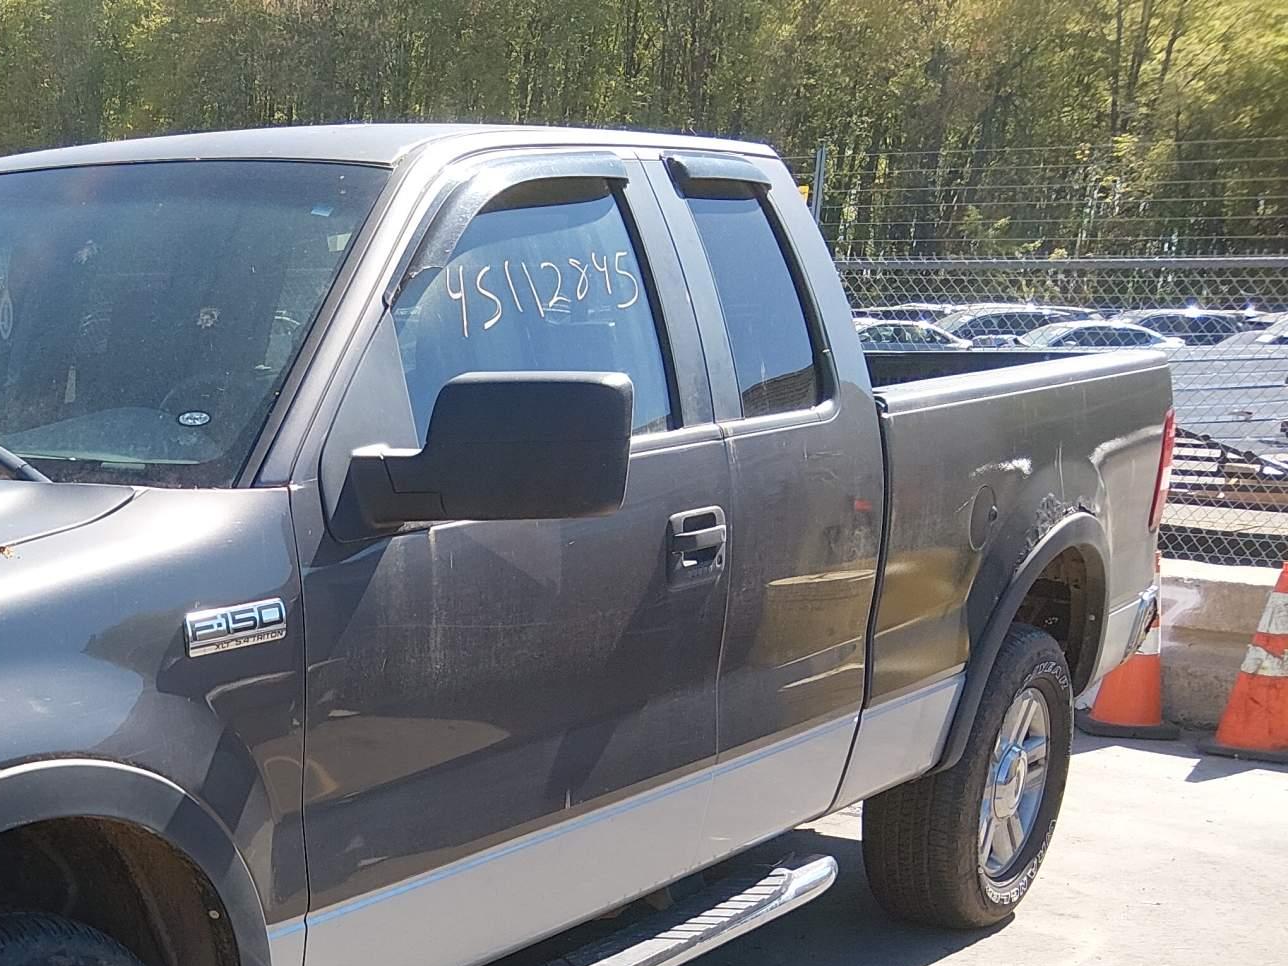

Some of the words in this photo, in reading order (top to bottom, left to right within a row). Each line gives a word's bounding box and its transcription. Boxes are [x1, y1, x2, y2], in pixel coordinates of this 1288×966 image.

[446, 251, 639, 338] 45112845
[190, 602, 284, 642] F-150
[252, 629, 285, 644] TRITON
